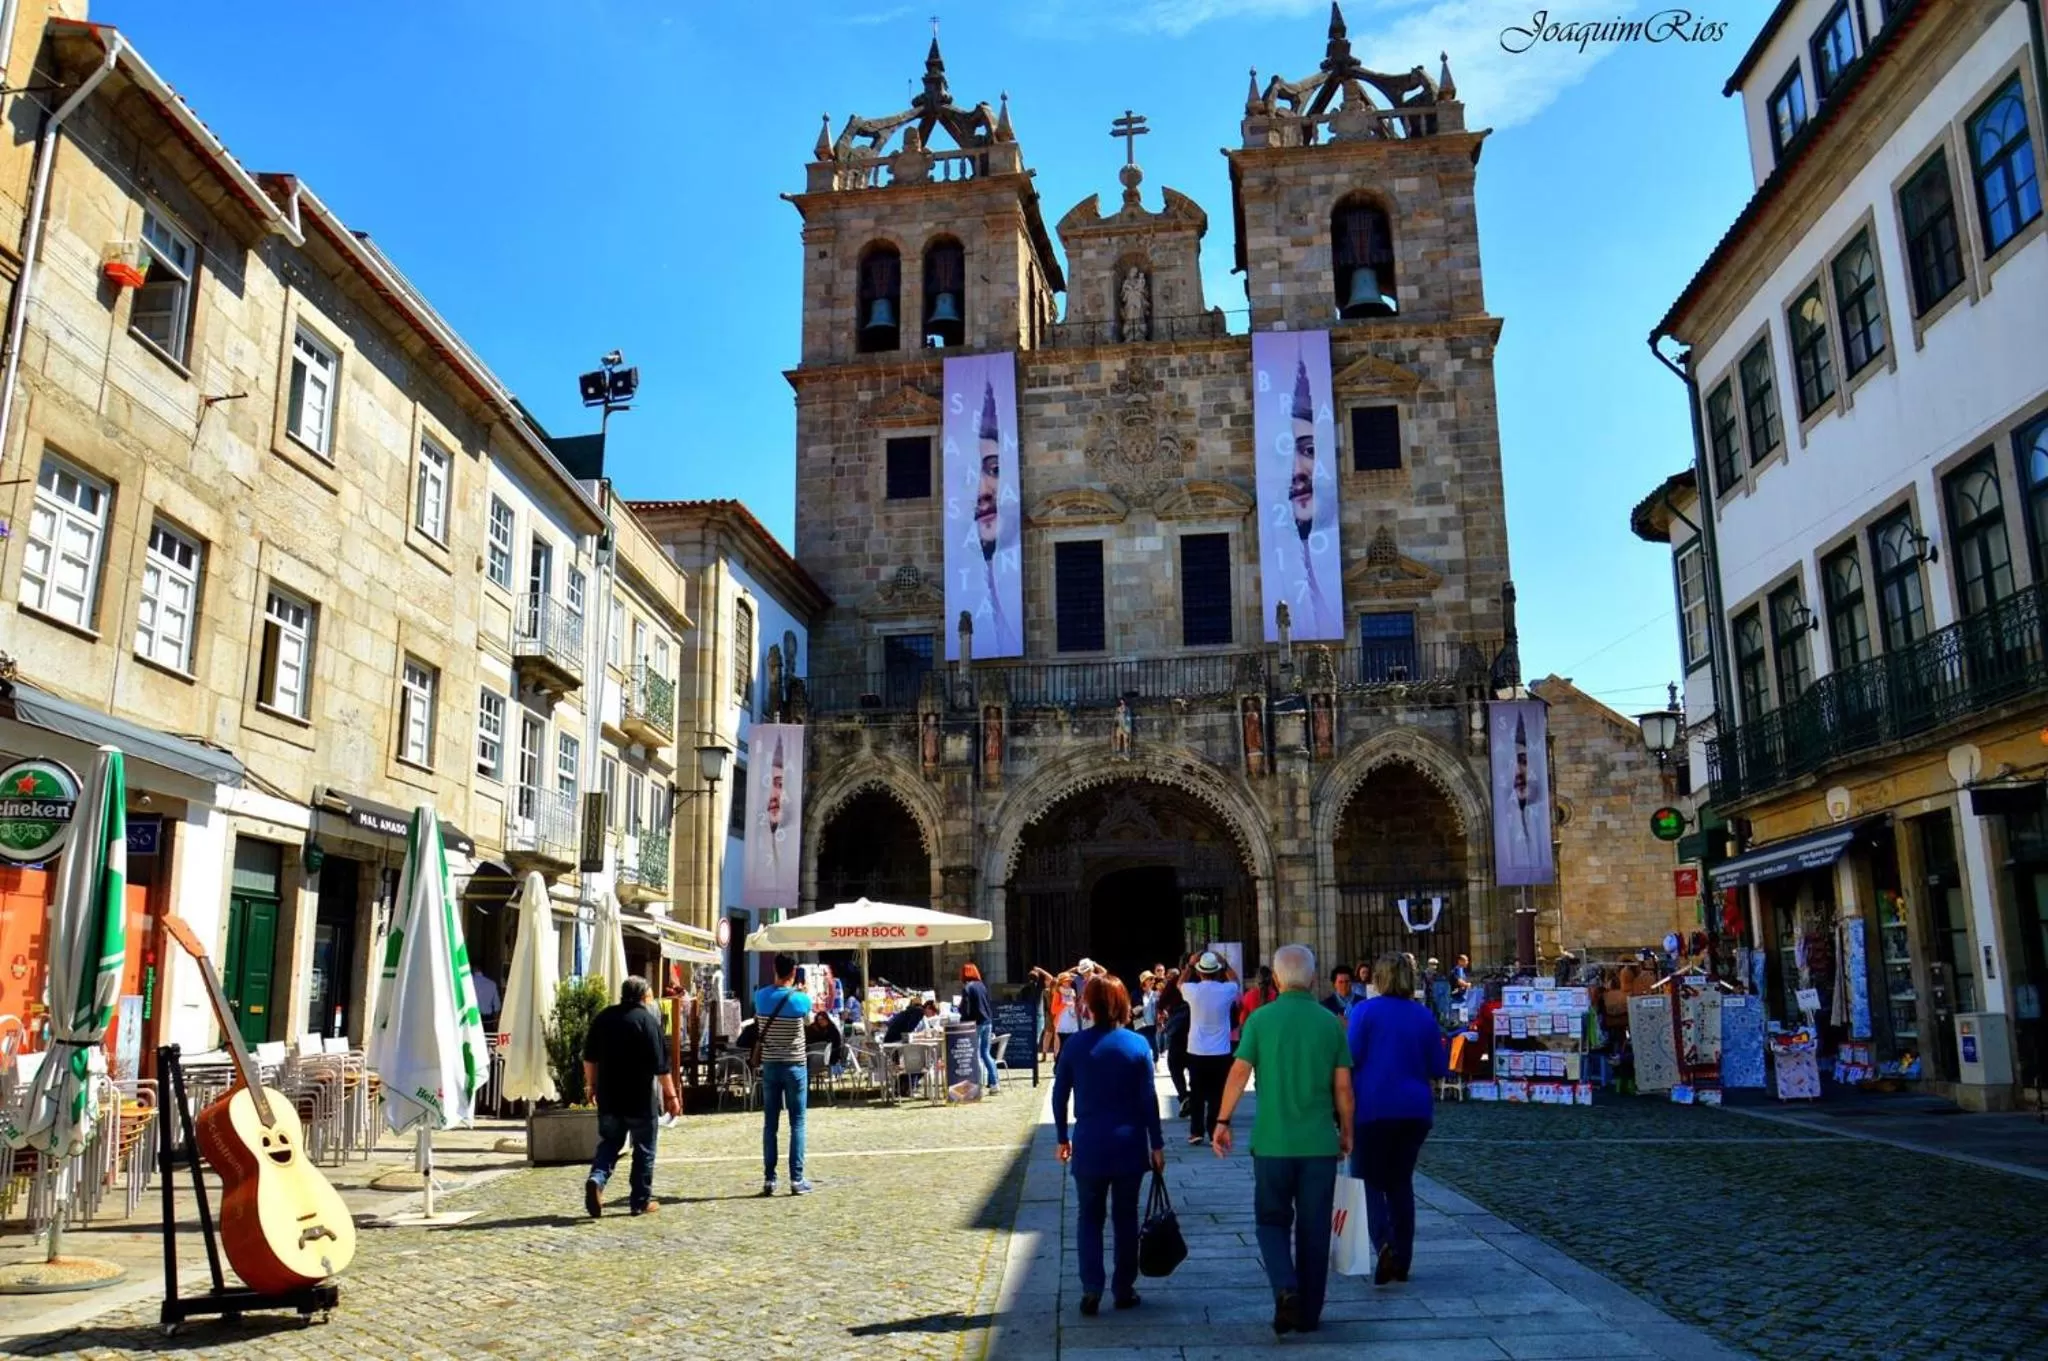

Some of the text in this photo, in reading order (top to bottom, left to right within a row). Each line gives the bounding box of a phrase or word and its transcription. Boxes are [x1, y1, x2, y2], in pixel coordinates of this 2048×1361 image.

[360, 813, 407, 836] MAL AMADO
[831, 926, 869, 937] SUPER
[871, 925, 906, 937] BOCK
